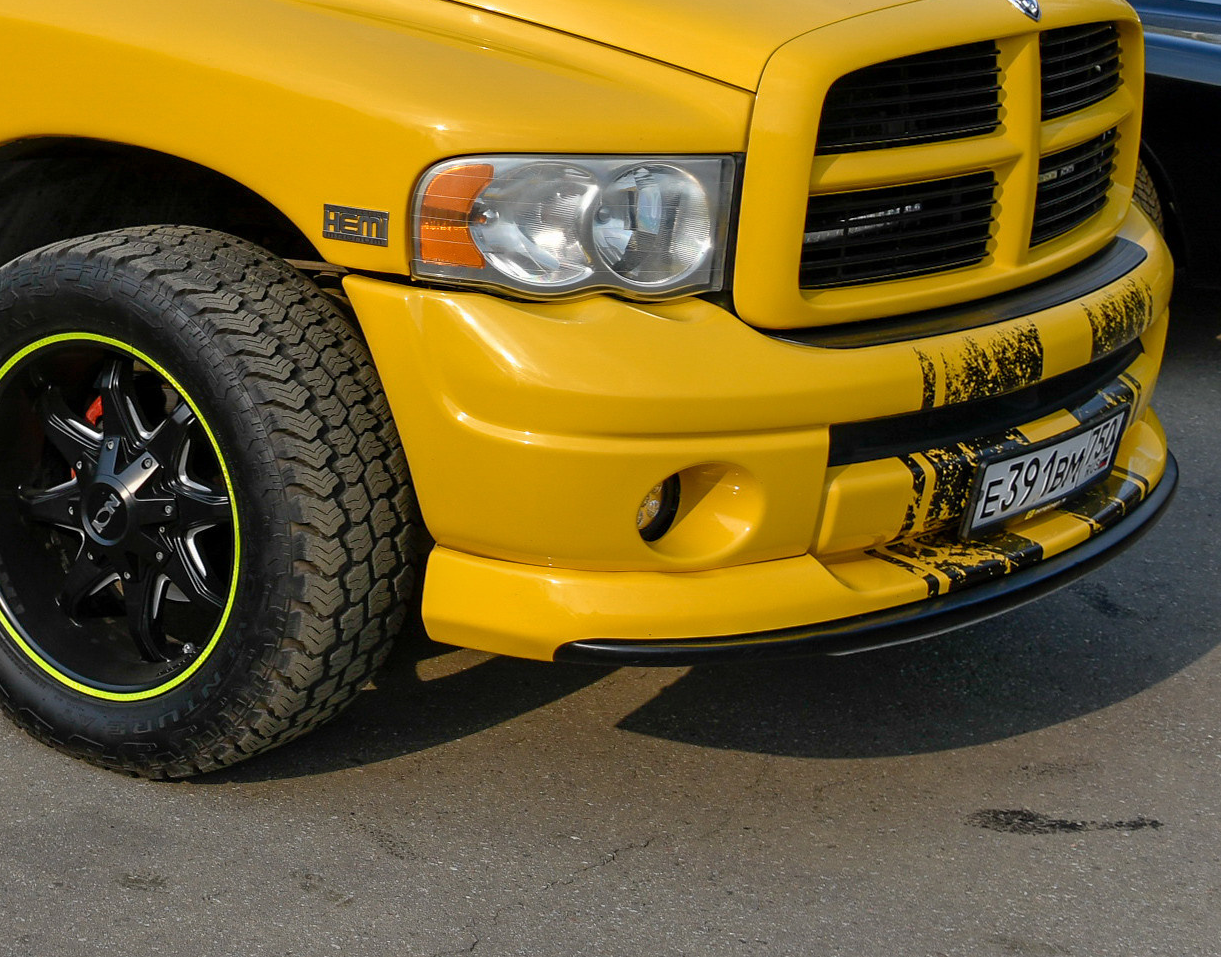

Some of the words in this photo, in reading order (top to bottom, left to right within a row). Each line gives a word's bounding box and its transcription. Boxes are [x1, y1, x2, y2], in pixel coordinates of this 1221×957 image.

[323, 205, 388, 241] HEMI
[1086, 418, 1118, 464] 750
[91, 494, 121, 533] ION
